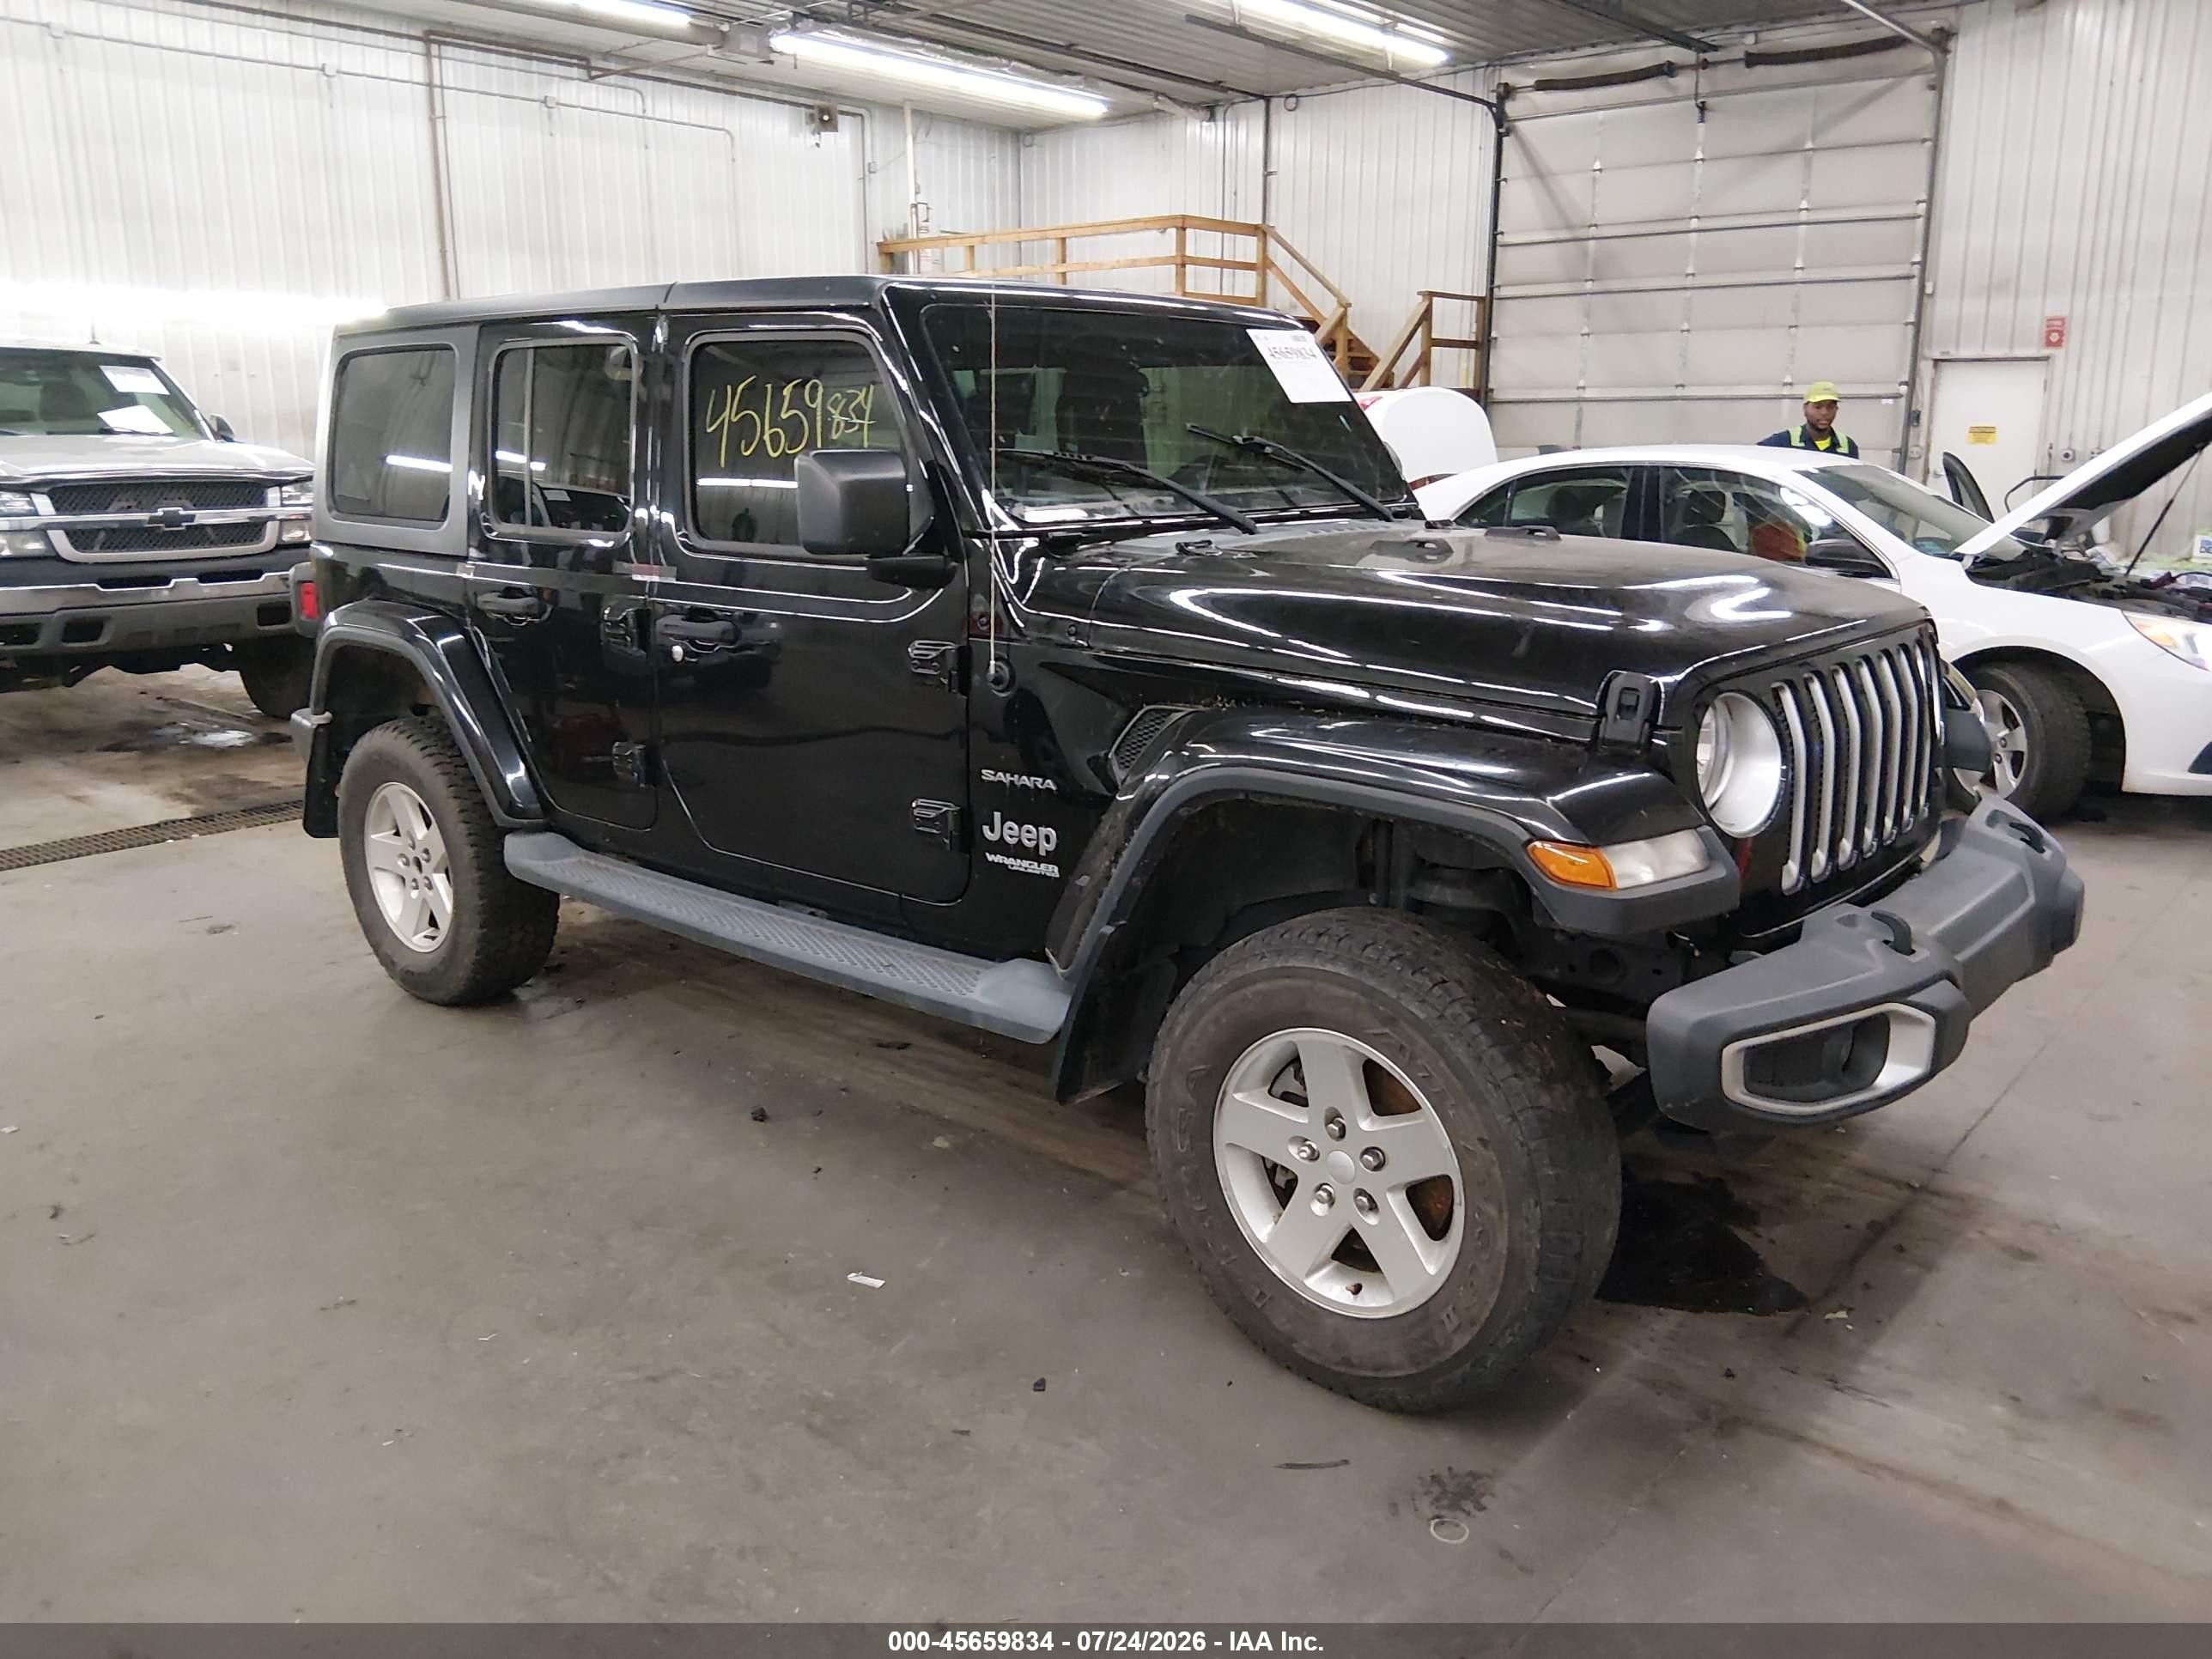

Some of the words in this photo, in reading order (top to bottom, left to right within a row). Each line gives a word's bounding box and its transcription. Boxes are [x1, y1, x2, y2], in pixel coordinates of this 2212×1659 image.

[705, 374, 876, 468] 45659834
[981, 769, 1057, 791] SAHARA
[982, 811, 1057, 856] Jeep
[984, 852, 1059, 874] WRANGLER
